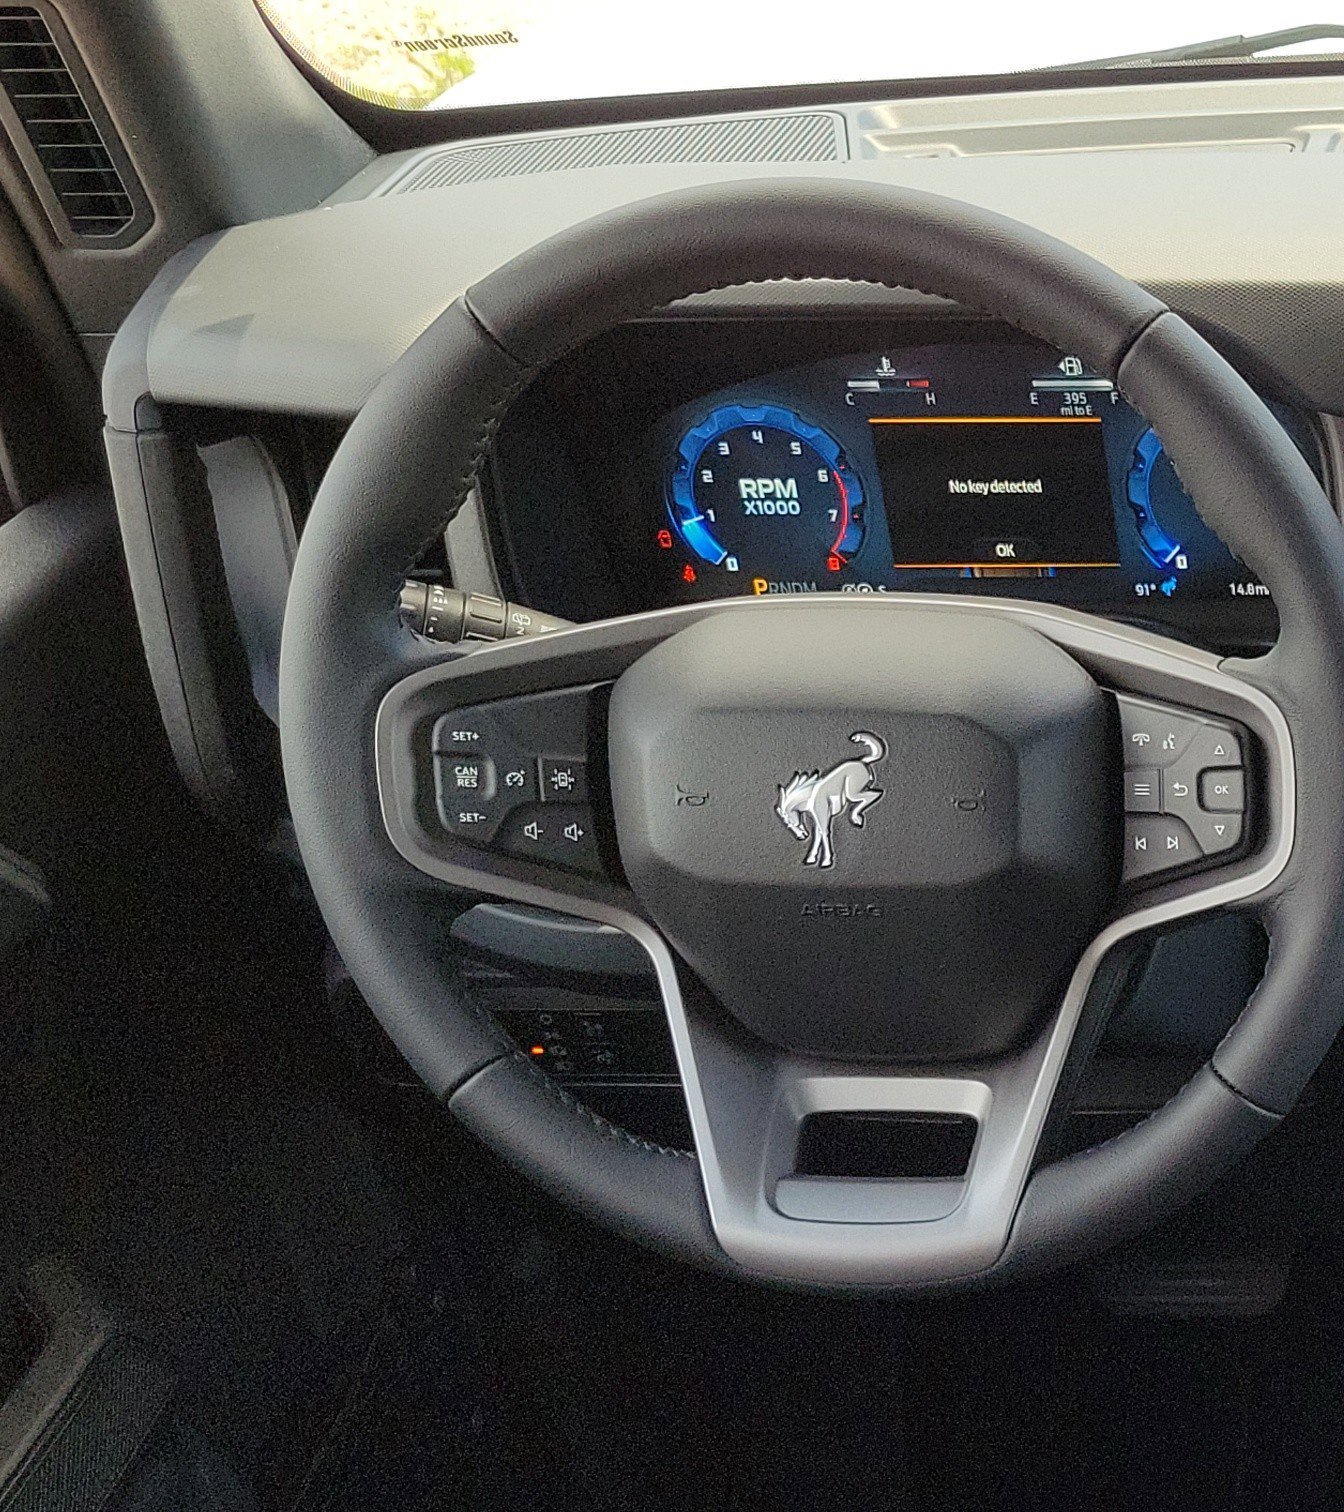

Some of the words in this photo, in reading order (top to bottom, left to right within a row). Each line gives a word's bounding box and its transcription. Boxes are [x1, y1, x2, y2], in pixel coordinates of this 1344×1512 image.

[845, 393, 855, 406] C
[925, 393, 936, 405] H
[1030, 393, 1038, 405] E
[1063, 392, 1087, 405] 395
[1111, 392, 1119, 405] F
[1075, 406, 1084, 416] to
[1085, 406, 1092, 416] E
[752, 430, 764, 443] 4
[718, 443, 730, 455] 3
[790, 442, 801, 455] 5
[702, 470, 714, 483] 2
[818, 470, 828, 482] 6
[738, 478, 799, 499] RPM
[949, 480, 968, 494] No
[968, 480, 990, 496] key
[990, 479, 1043, 494] detected
[743, 500, 800, 515] X1000
[707, 510, 715, 522] 1
[828, 509, 838, 522] 7
[995, 543, 1016, 558] OK
[726, 557, 739, 571] 0
[827, 557, 841, 571] 8
[452, 731, 480, 742] SET+
[455, 767, 478, 776] CAN
[457, 778, 478, 787] RES
[1214, 785, 1229, 794] OK
